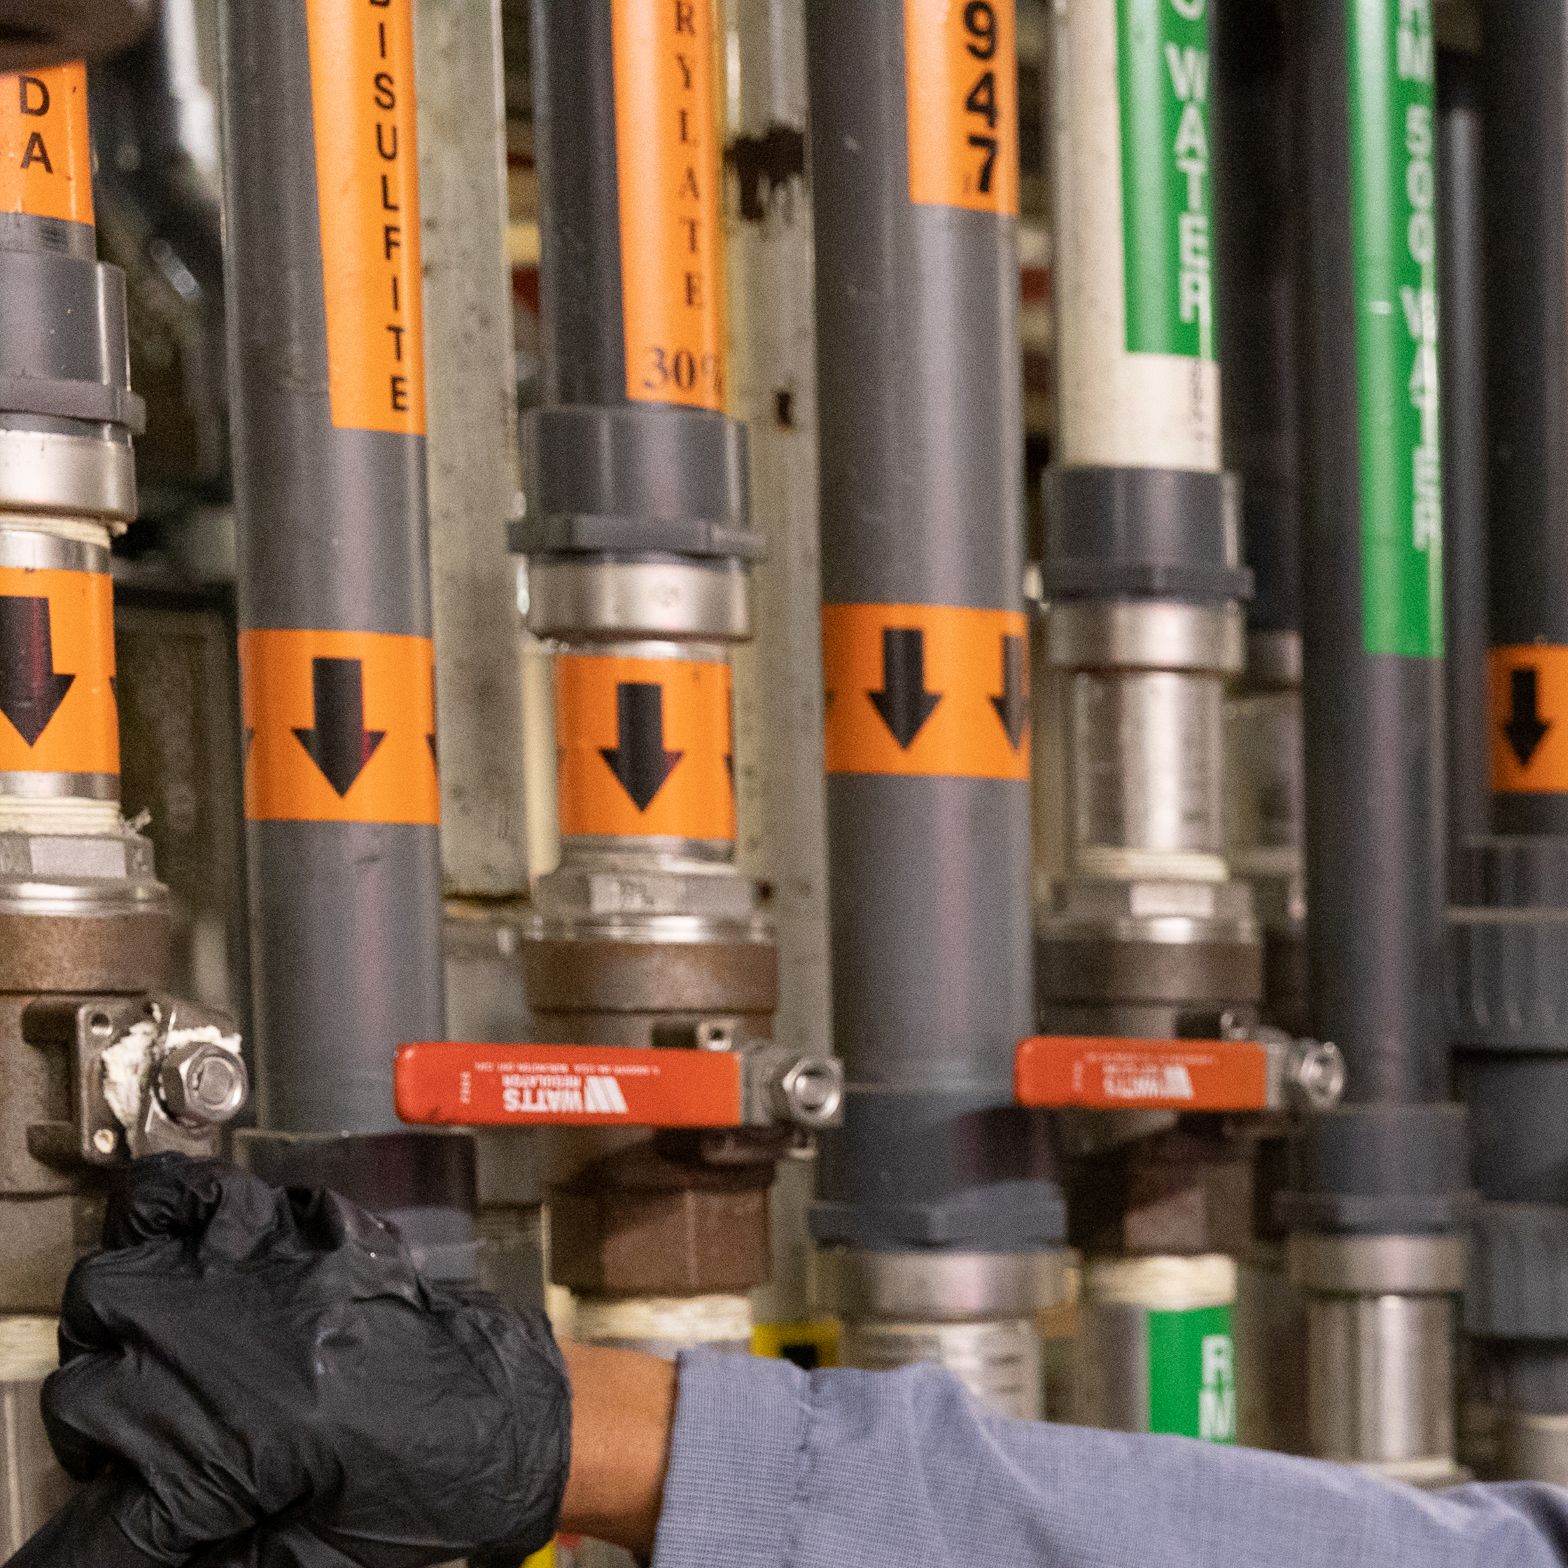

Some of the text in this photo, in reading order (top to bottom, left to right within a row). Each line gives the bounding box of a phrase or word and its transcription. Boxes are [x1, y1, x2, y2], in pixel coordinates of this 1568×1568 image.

[19, 75, 53, 175] DA
[963, 0, 998, 192] 947
[1165, 42, 1211, 324] WATER
[369, 0, 409, 411] ISULFITE
[503, 1087, 584, 1113] WATTS
